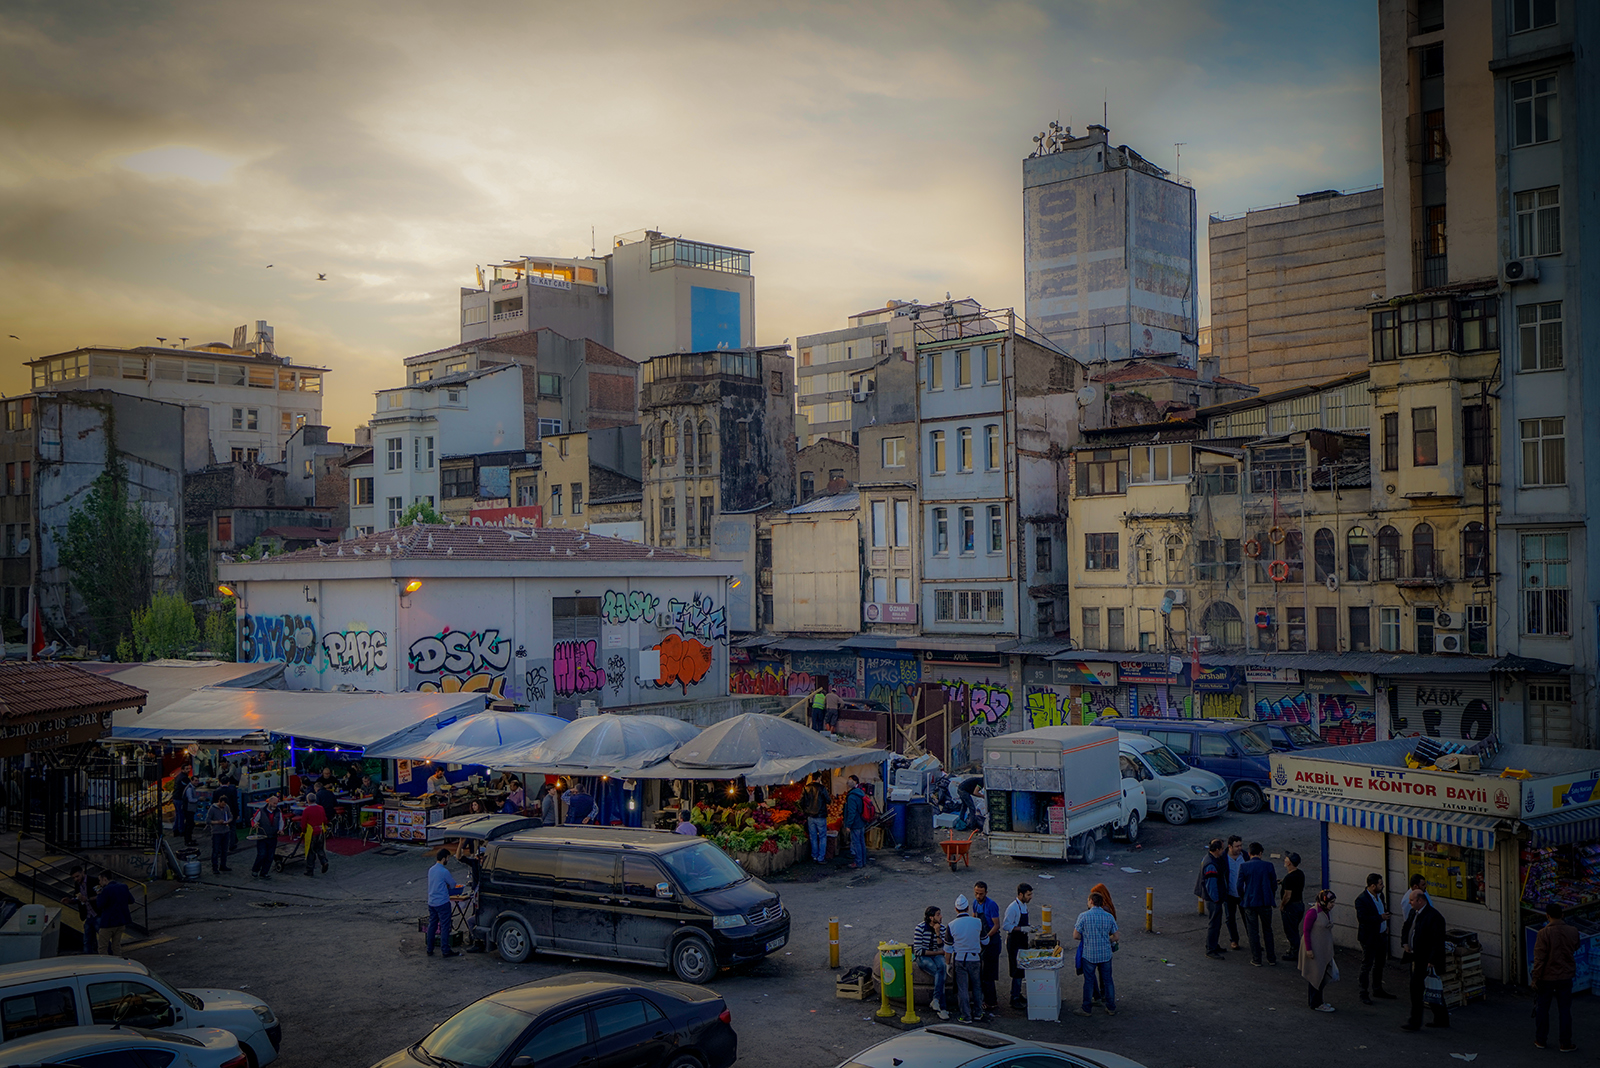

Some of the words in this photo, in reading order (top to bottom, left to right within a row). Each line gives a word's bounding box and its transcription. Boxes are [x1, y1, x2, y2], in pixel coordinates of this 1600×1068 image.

[409, 630, 511, 674] DSK
[1343, 776, 1363, 789] VE
[1368, 777, 1437, 797] KÖNTOR
